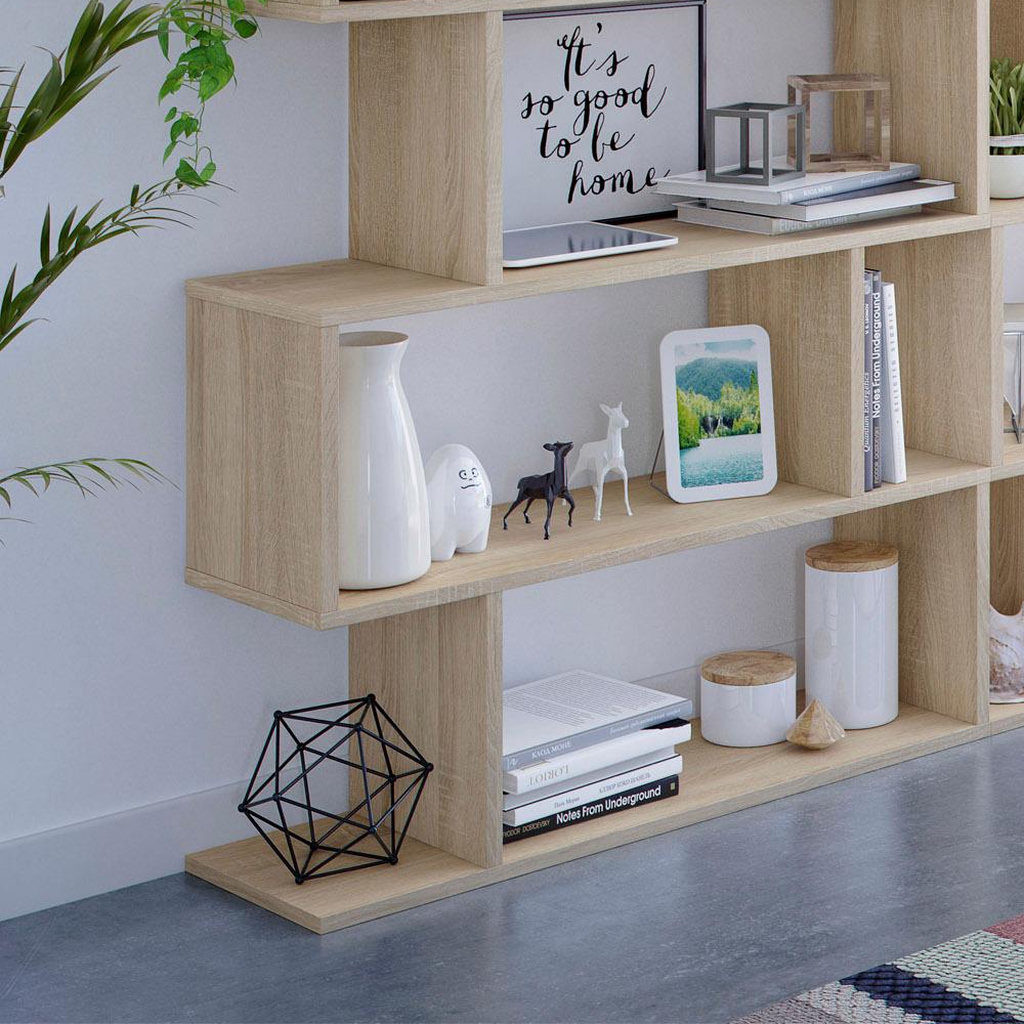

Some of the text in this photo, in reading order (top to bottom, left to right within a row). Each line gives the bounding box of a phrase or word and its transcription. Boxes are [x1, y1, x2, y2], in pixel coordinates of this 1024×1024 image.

[557, 22, 628, 92] It's
[521, 64, 667, 136] so good
[536, 112, 636, 162] to be
[568, 160, 671, 204] home
[872, 292, 881, 358] Underground
[872, 362, 881, 386] From
[872, 389, 881, 418] Notes
[556, 810, 581, 824] Notes
[582, 804, 604, 817] From
[605, 786, 661, 810] Underground
